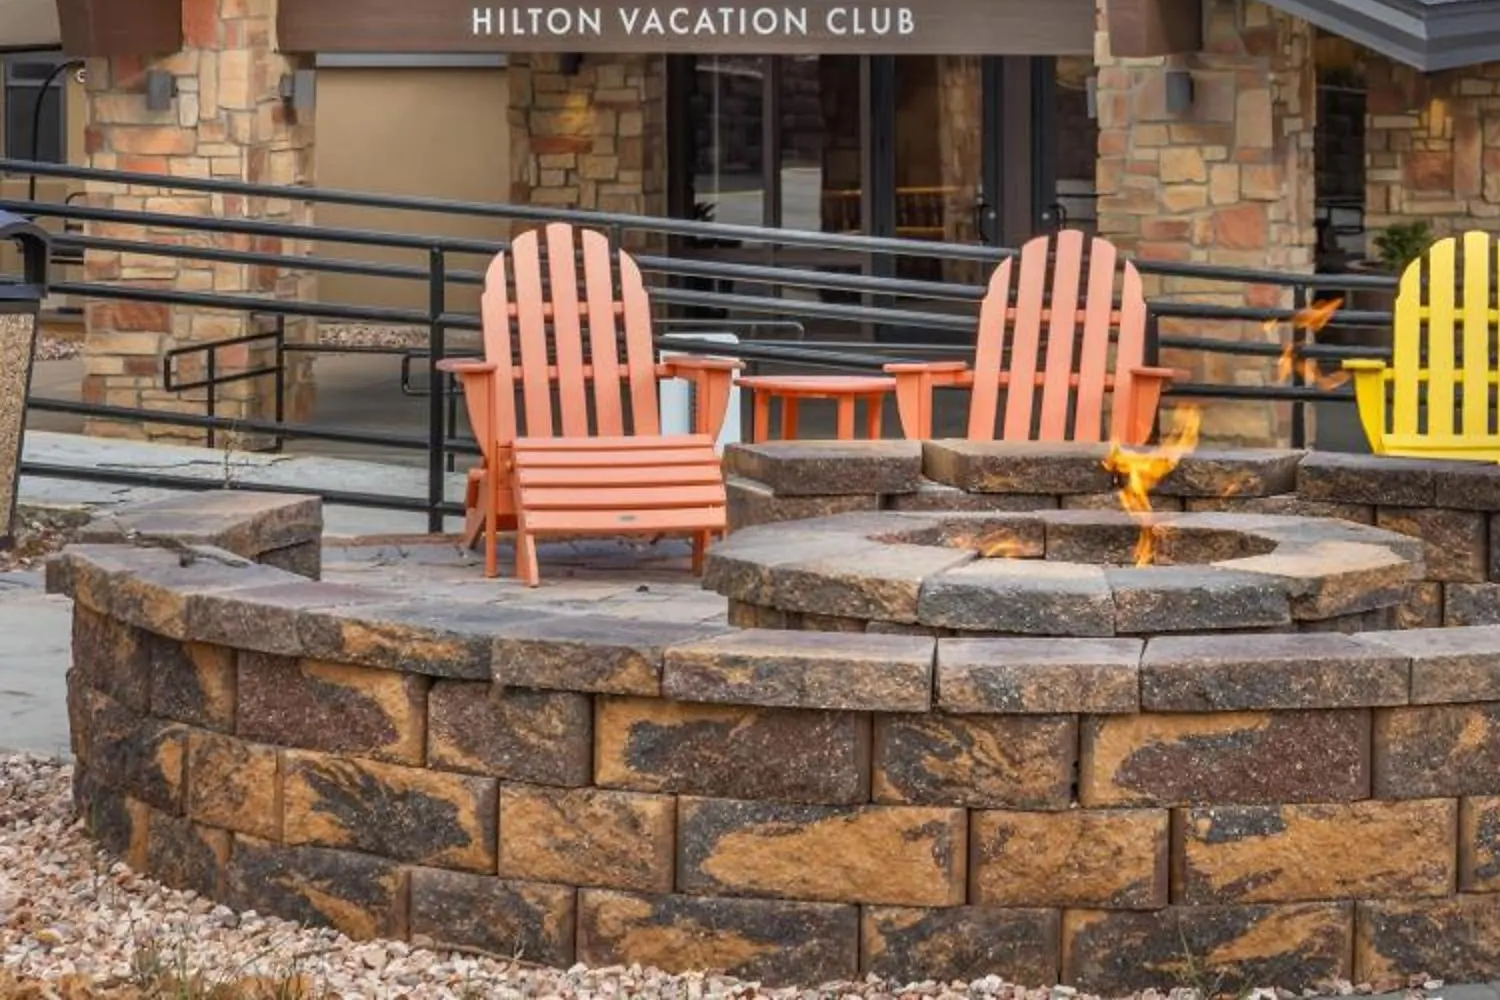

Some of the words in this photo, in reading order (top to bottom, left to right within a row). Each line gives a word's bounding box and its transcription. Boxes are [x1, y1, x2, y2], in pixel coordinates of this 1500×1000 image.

[471, 7, 602, 36] HILTON
[618, 7, 809, 36] VACATION
[825, 7, 916, 36] CLUB
